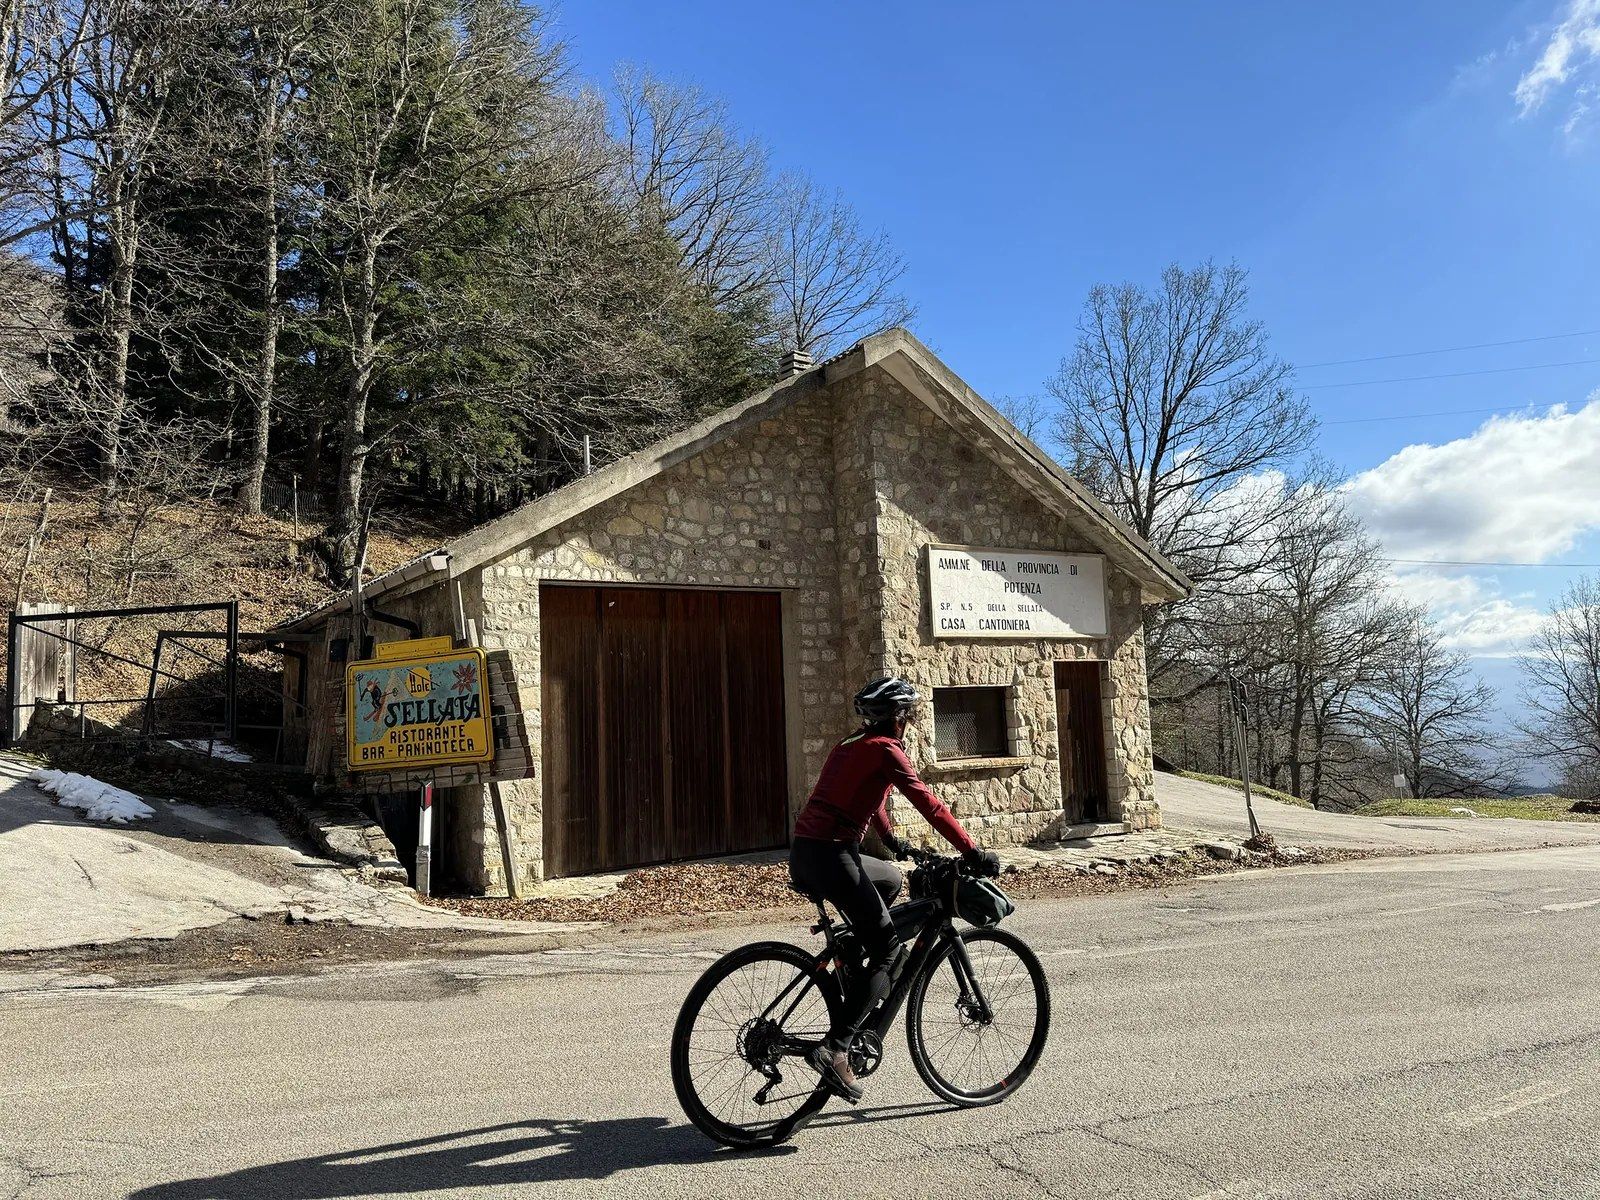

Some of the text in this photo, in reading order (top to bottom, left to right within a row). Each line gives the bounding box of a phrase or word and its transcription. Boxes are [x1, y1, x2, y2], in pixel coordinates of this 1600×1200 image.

[981, 559, 1007, 573] DELLA
[1017, 561, 1060, 575] PROVINCIA
[1070, 564, 1078, 576] DI
[1004, 581, 1042, 595] POTENZA
[940, 602, 953, 612] S.P.
[987, 603, 1007, 612] DELLA
[1017, 604, 1044, 613] SELLATA
[941, 618, 1031, 631] CASA CANTONIERA
[384, 693, 482, 728] SELLATA
[362, 746, 385, 760] BAR
